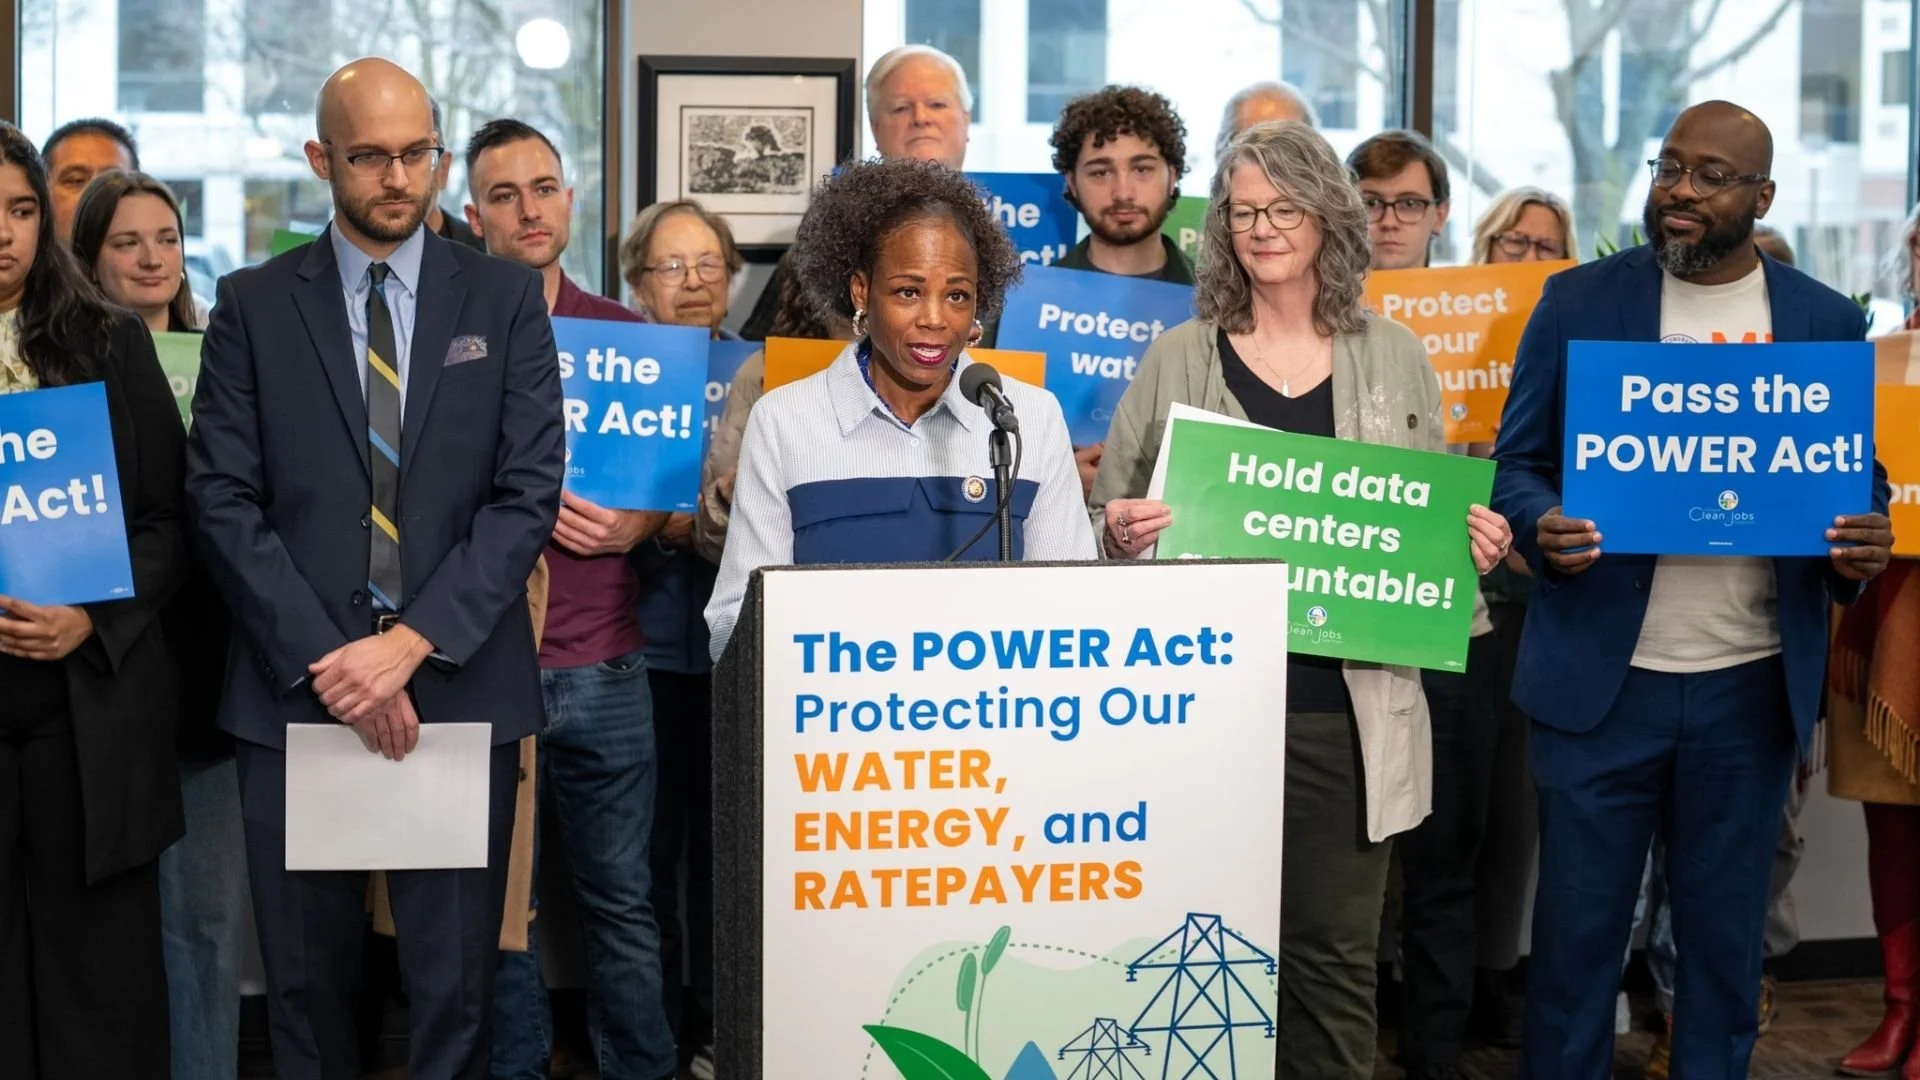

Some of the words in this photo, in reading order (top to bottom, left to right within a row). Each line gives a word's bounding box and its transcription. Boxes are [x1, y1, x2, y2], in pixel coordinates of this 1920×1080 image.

[984, 195, 1040, 228] he
[1383, 288, 1508, 320] Protect
[586, 347, 660, 384] the
[1071, 352, 1137, 381] wat
[1621, 375, 1739, 414] Pass
[1752, 374, 1830, 413] the
[599, 401, 692, 439] Act!
[0, 428, 57, 464] he
[1576, 433, 1757, 473] POWER
[1769, 433, 1863, 473] Act!
[1, 473, 108, 525] Act!
[1227, 451, 1324, 494] Hold
[1331, 465, 1431, 508] data
[1242, 510, 1401, 553] centers
[1688, 506, 1726, 522] Clean
[1723, 511, 1755, 528] Jobs
[793, 631, 897, 674] The
[912, 628, 1111, 672] POWER
[1124, 626, 1234, 668] Act:
[1287, 620, 1313, 636] lean
[1310, 628, 1343, 644] Jobs
[795, 686, 1081, 742] Protecting
[1098, 687, 1195, 727] Our
[793, 748, 1008, 795] WATER,
[793, 807, 1025, 853] ENERGY,
[1043, 801, 1148, 844] and
[793, 860, 1144, 912] RATEPAYERS
